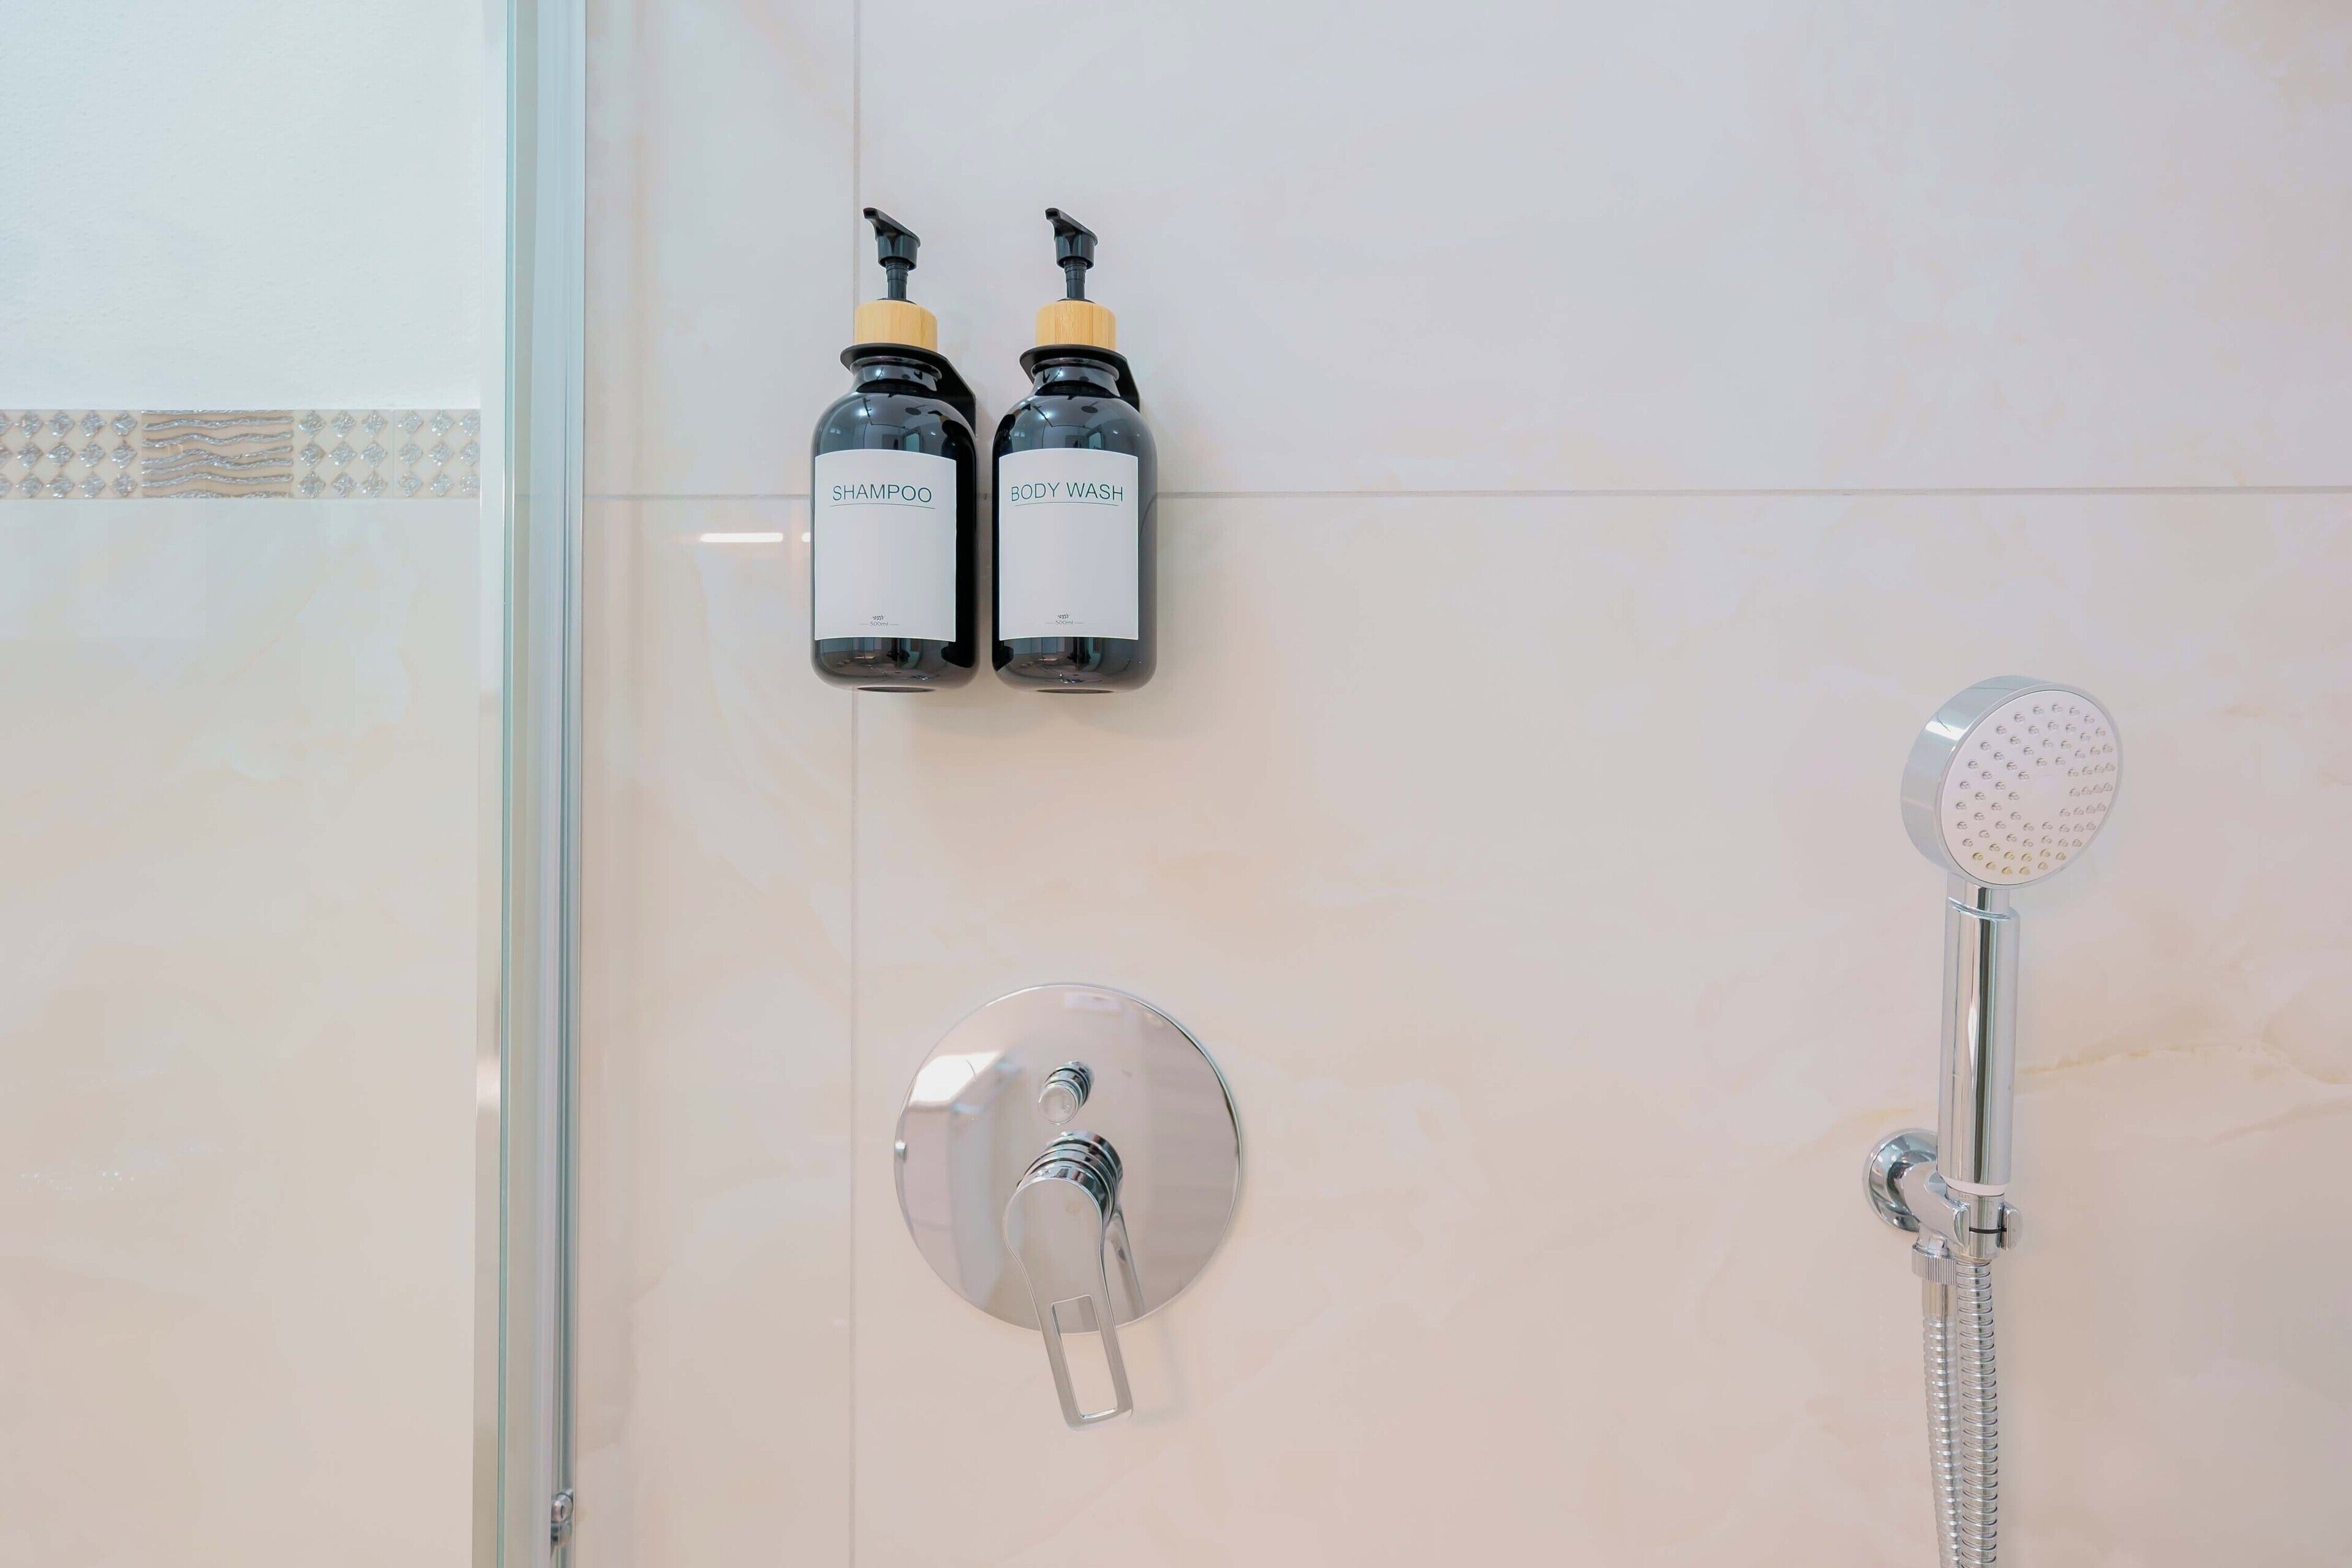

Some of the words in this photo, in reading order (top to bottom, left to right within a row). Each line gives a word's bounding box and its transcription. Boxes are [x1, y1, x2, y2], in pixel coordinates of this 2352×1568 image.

[832, 483, 932, 503] SHAMPOO
[1011, 483, 1060, 502] BODY
[1066, 483, 1123, 502] WASH
